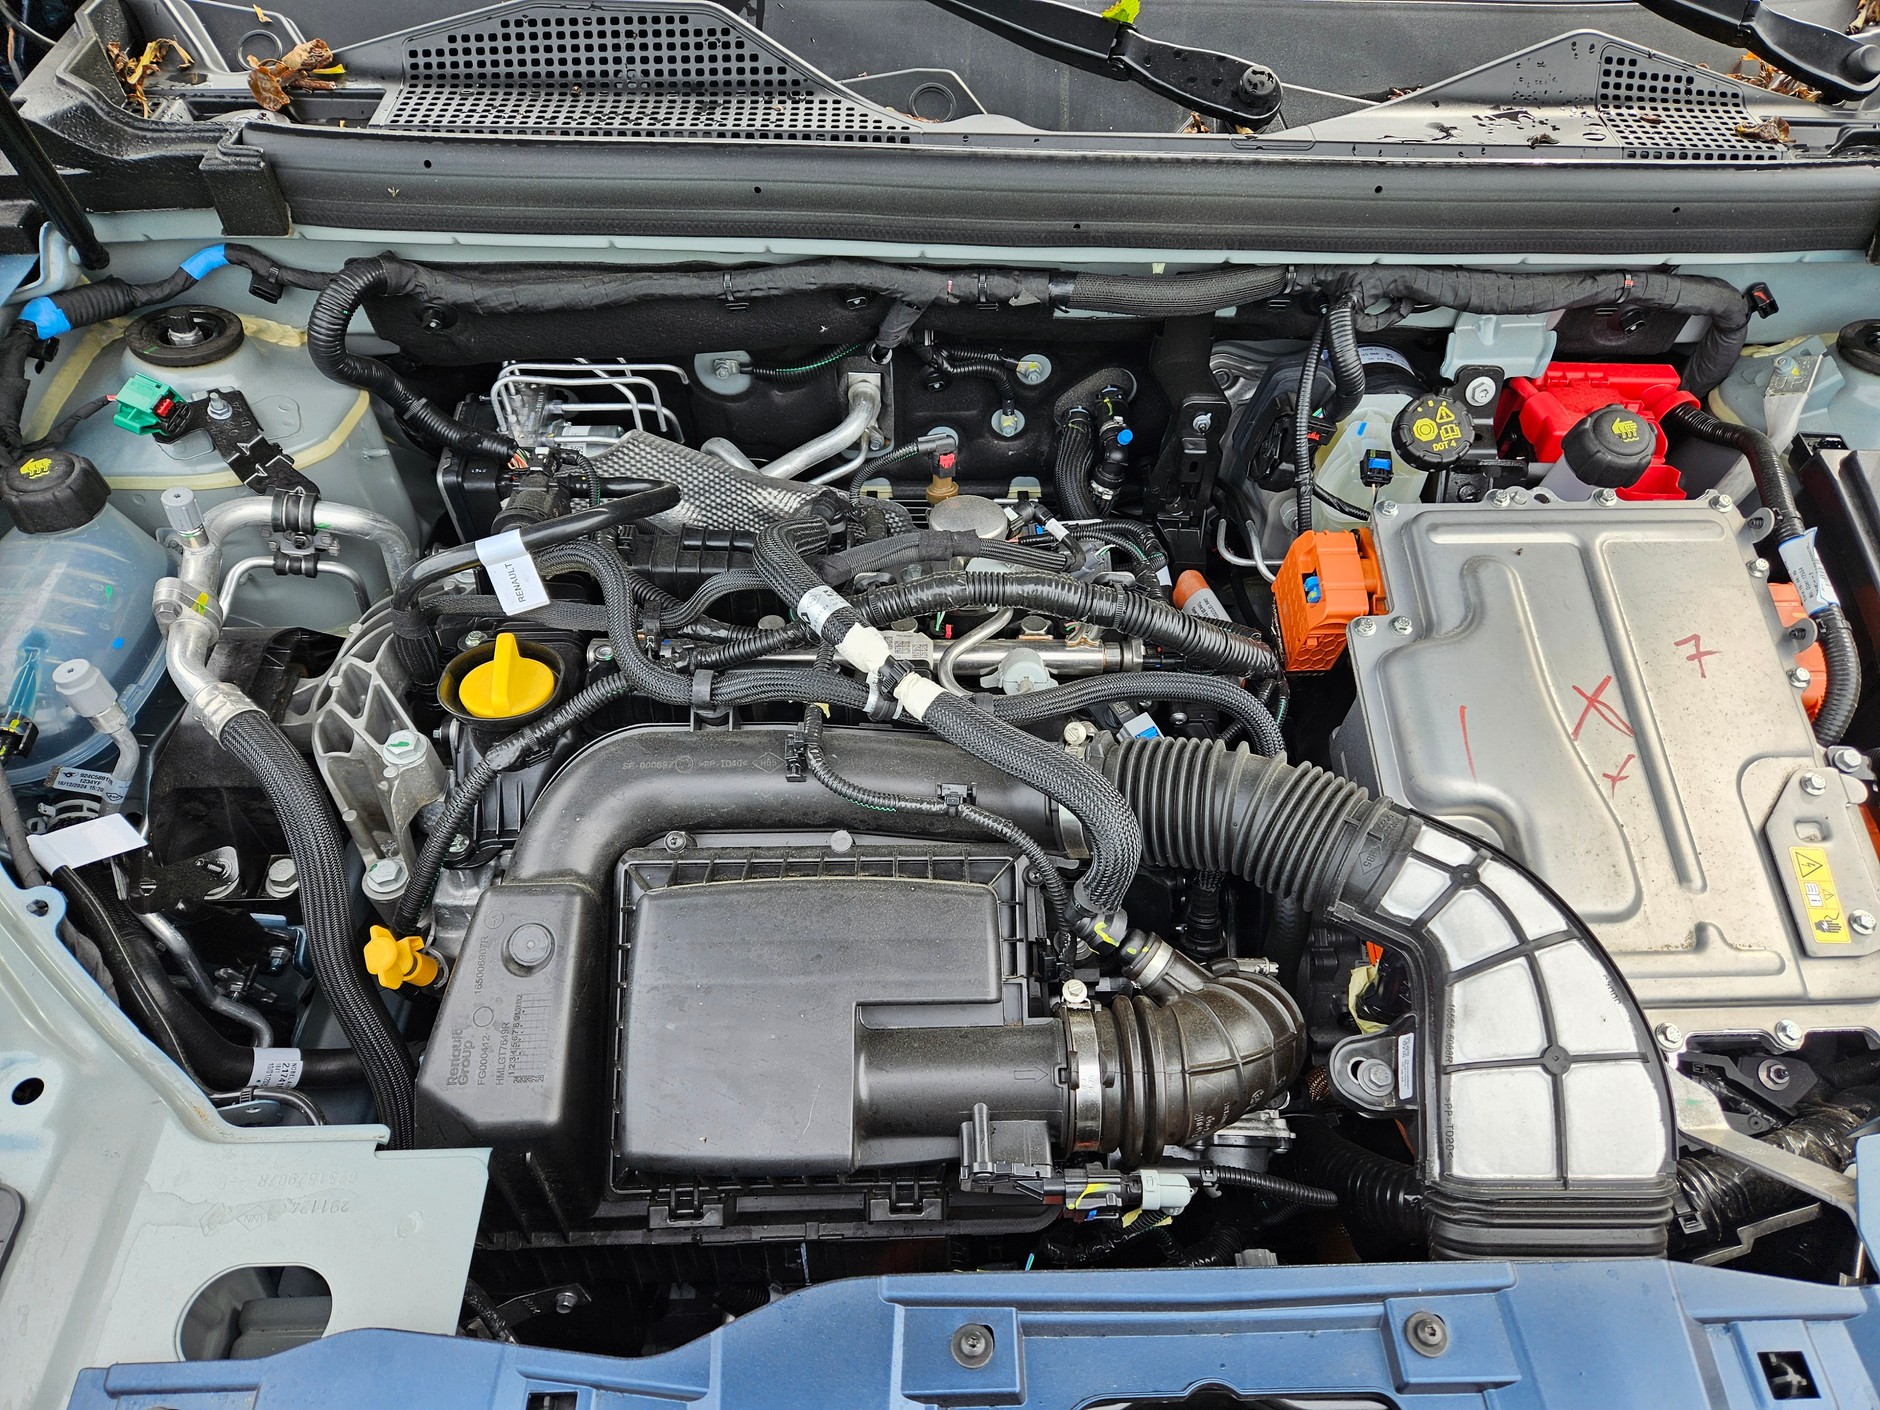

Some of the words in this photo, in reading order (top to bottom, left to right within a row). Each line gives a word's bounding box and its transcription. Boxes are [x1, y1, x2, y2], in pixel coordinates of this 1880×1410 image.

[1432, 441, 1449, 451] DOT
[504, 563, 526, 602] RENAULT
[474, 935, 489, 994] 165006907R
[288, 1063, 297, 1080] NOBEL
[446, 1028, 463, 1086] Renault
[458, 1040, 475, 1085] Group
[478, 1035, 490, 1086] FG000412
[496, 1022, 510, 1086] HMLGT7649R
